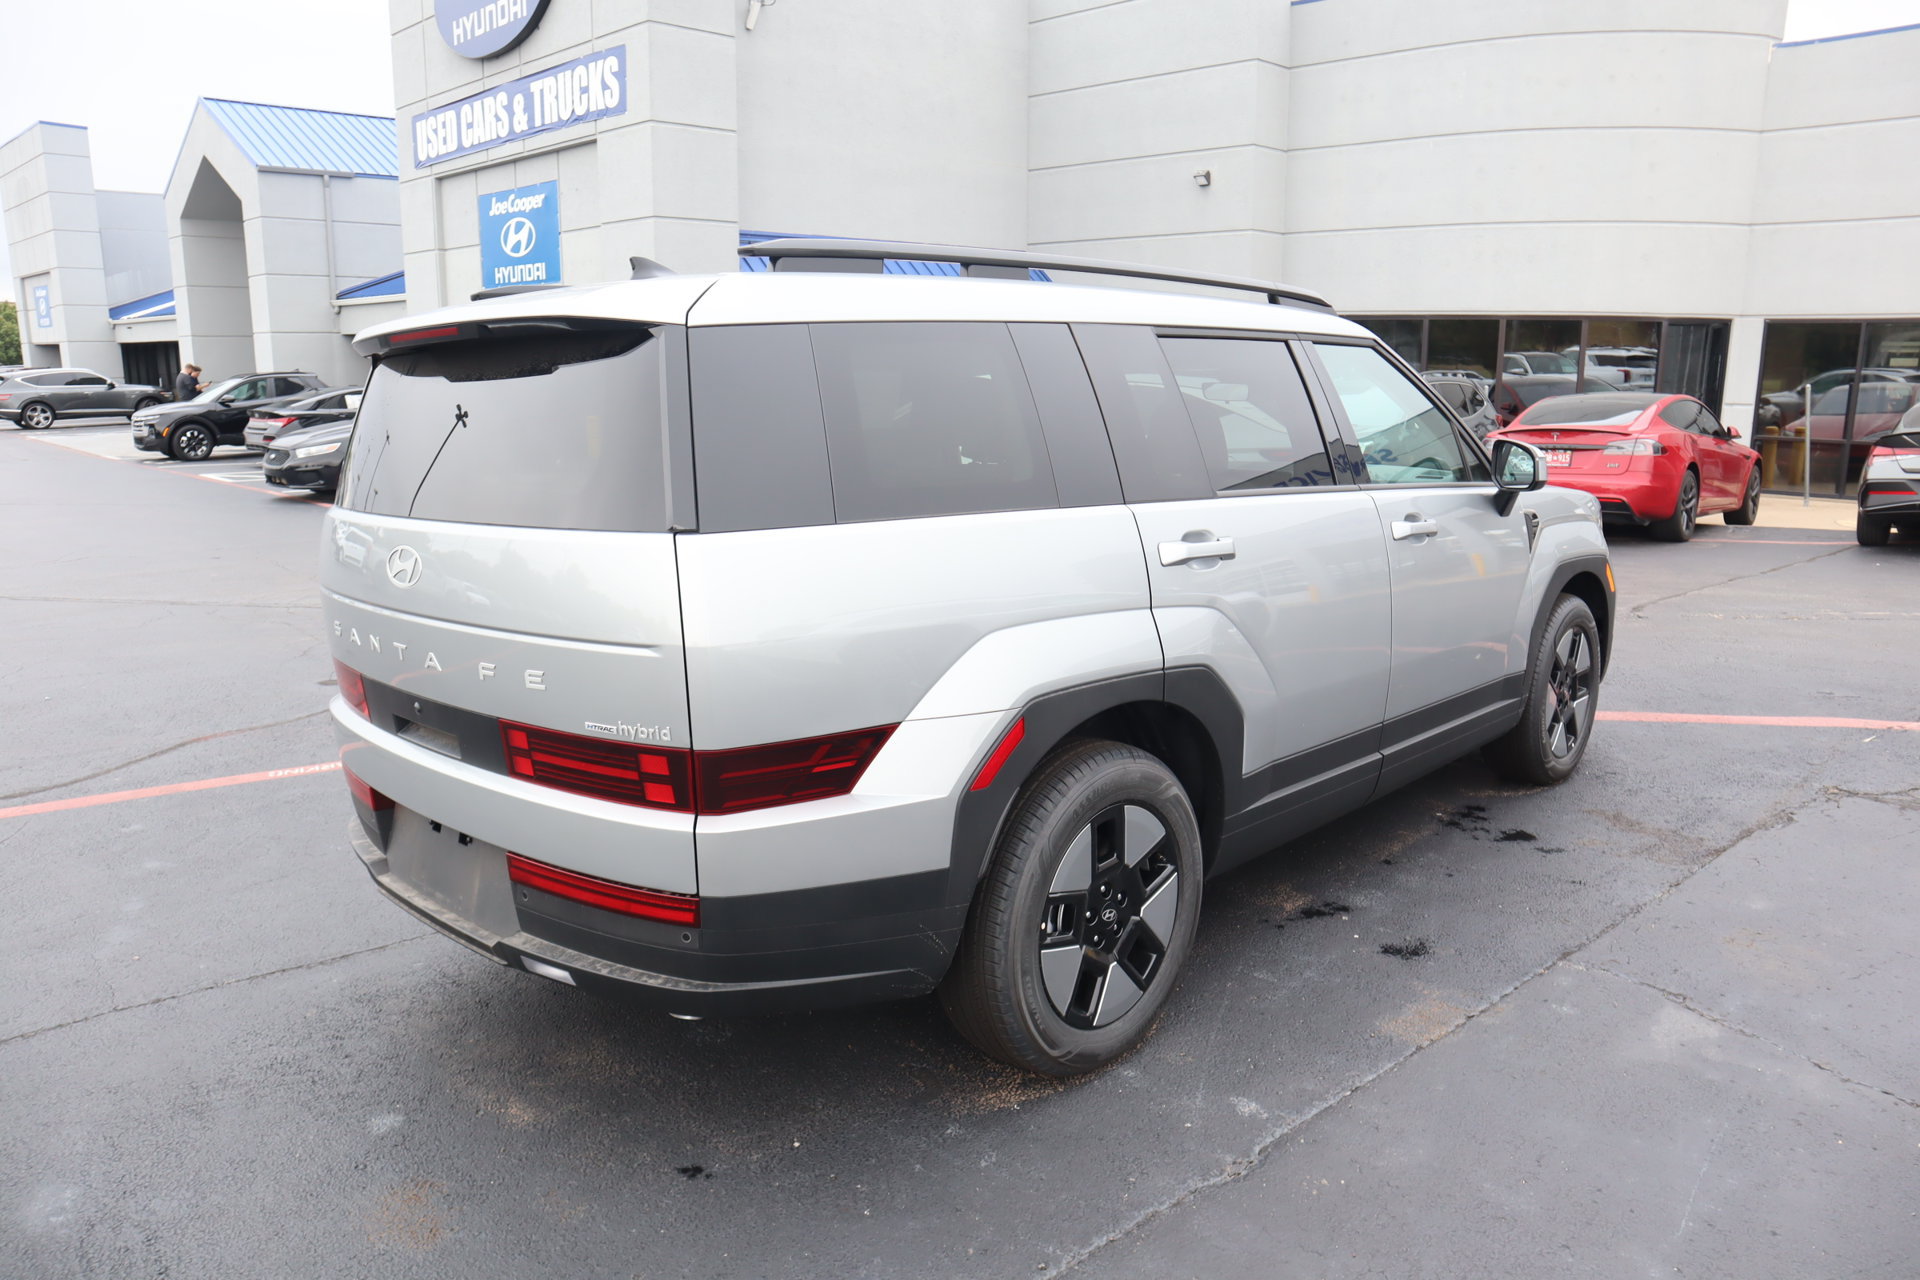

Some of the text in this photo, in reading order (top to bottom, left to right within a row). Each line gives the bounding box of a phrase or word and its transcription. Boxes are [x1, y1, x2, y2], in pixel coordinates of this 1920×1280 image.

[452, 0, 527, 46] HYUNDAI
[416, 55, 620, 161] USED CARS & TRUCKS
[495, 262, 546, 284] HYUNDAI
[334, 620, 546, 691] SANTA FE
[586, 720, 672, 741] HTRAC hybrid
